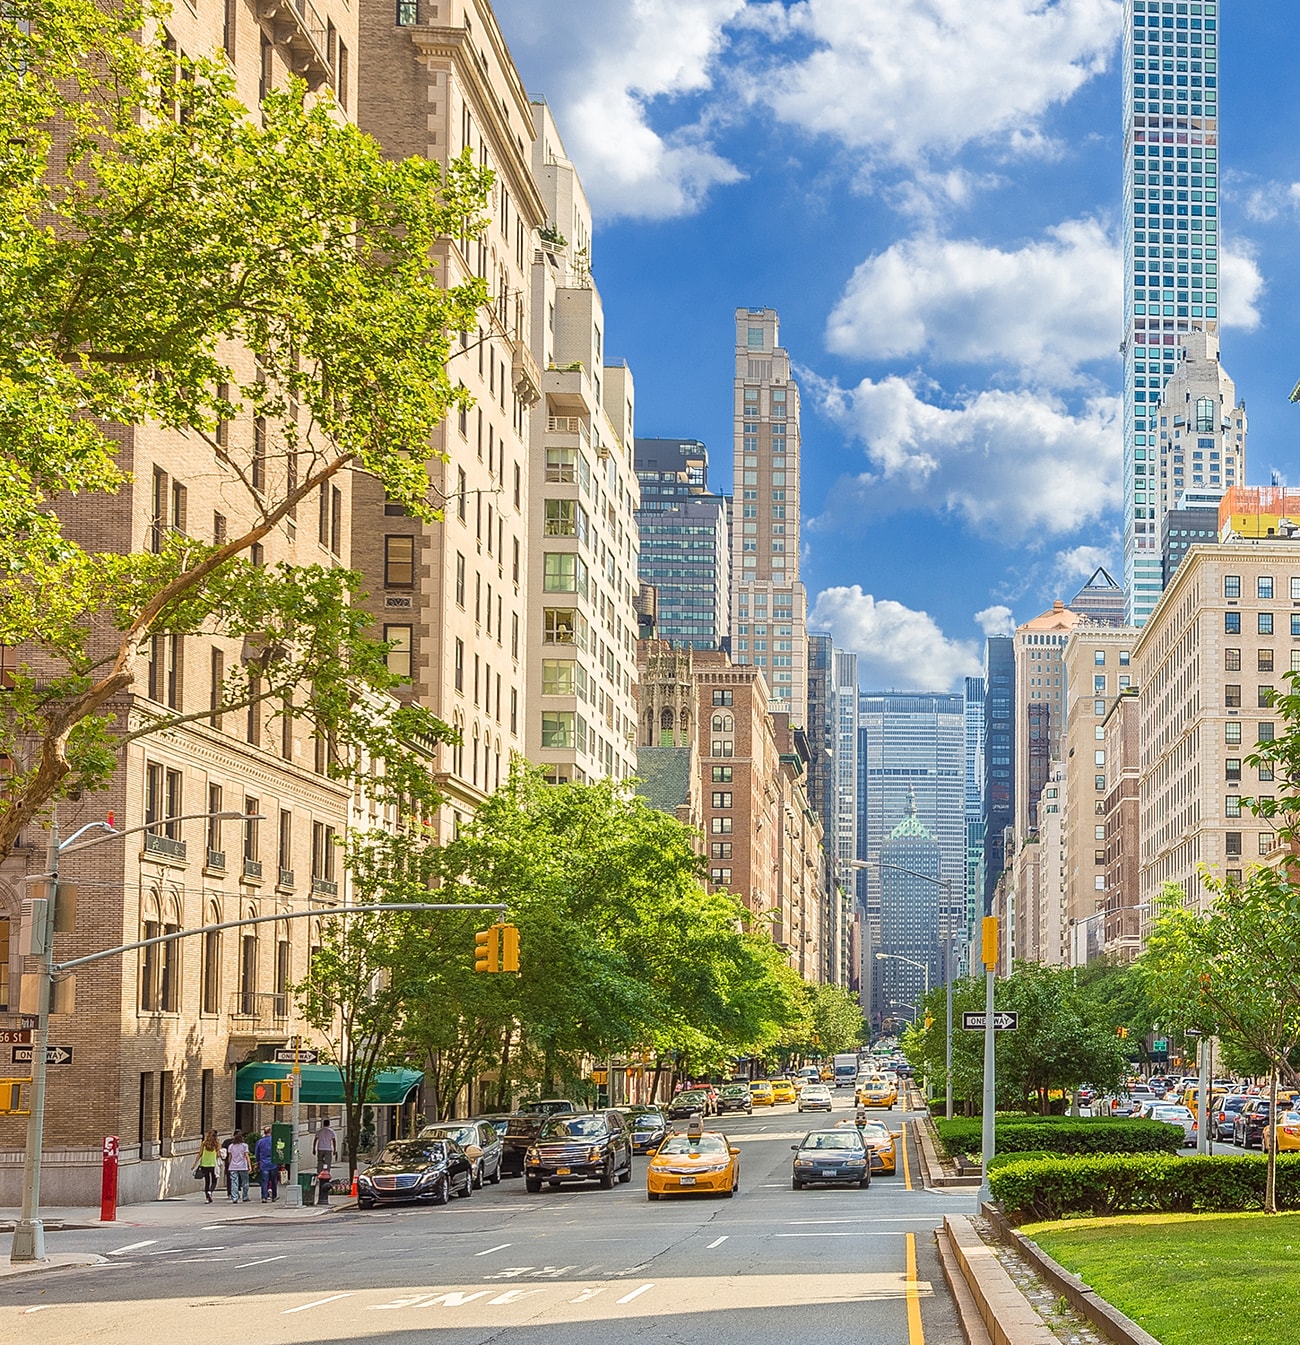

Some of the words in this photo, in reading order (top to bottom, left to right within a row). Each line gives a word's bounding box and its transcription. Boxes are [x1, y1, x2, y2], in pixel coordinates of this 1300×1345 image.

[970, 1017, 987, 1025] ONE
[993, 1017, 1009, 1025] WAY
[13, 1032, 22, 1043] St
[46, 1051, 64, 1060] WAY
